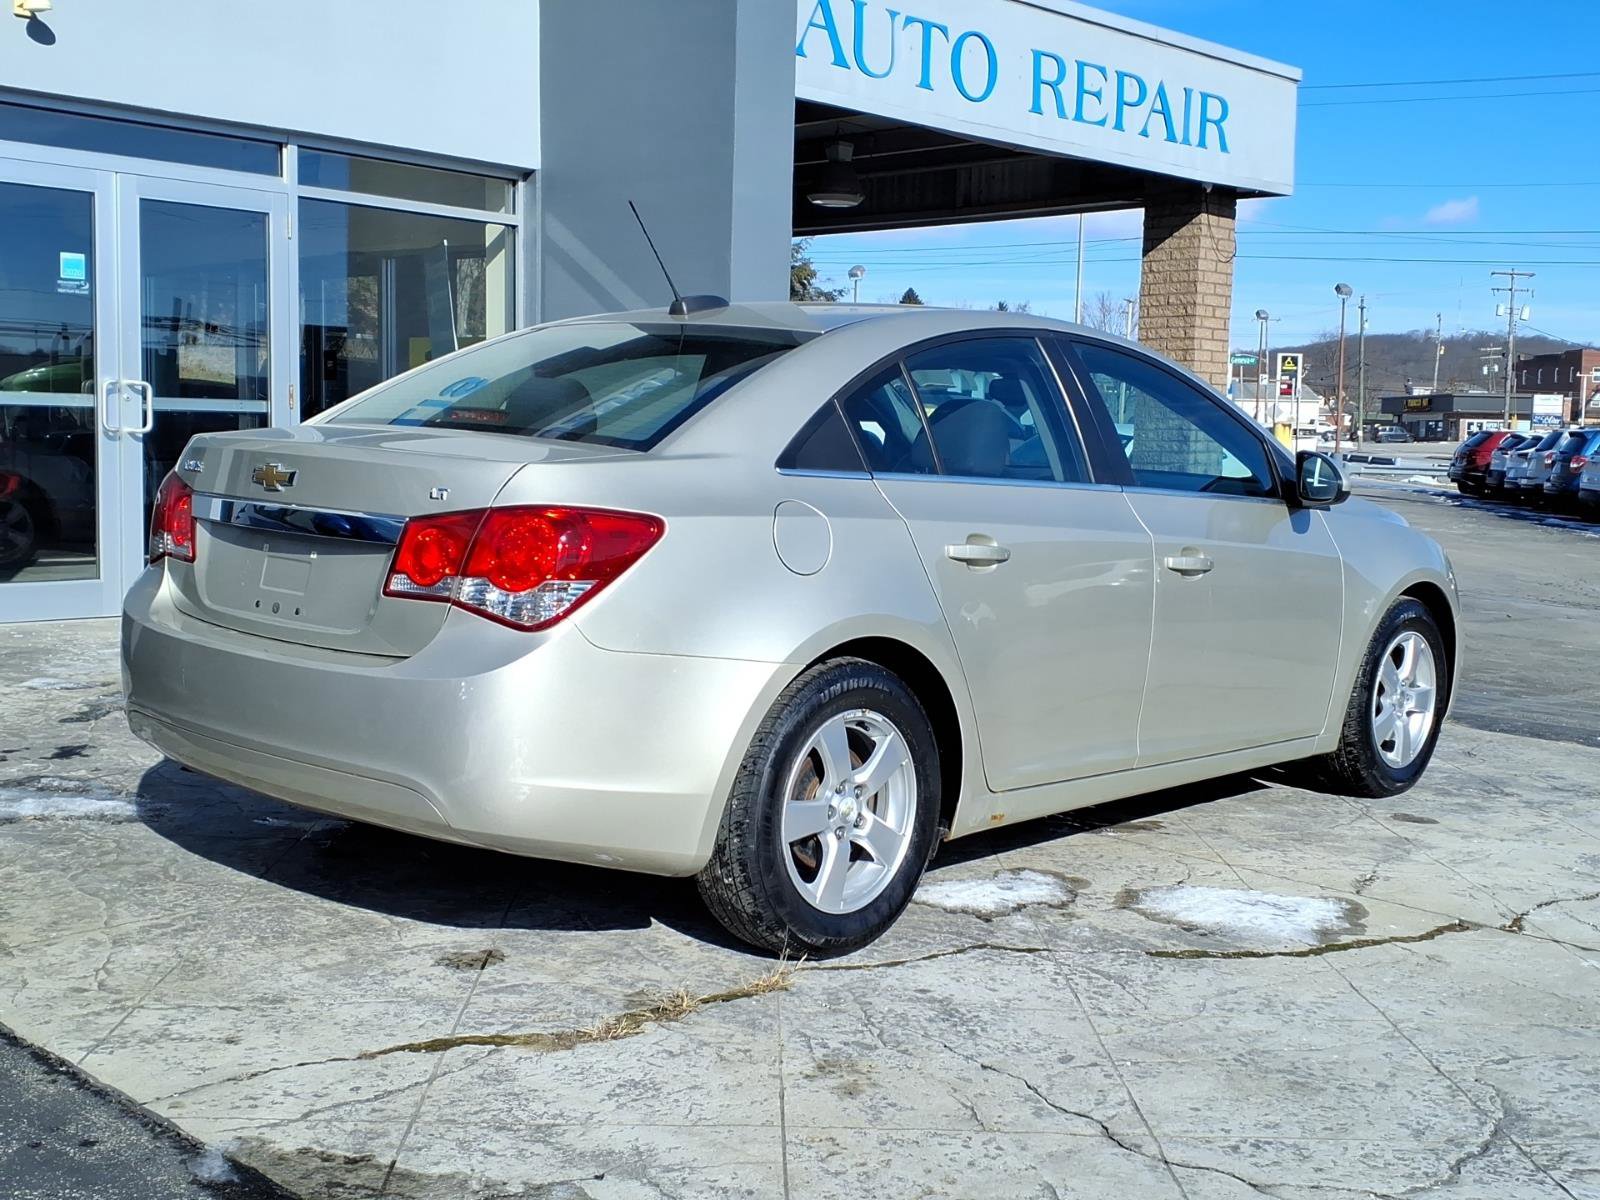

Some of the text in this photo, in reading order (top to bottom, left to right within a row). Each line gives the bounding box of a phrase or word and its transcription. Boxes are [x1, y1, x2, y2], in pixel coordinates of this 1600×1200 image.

[796, 0, 1231, 154] AUTO REPAIR
[429, 487, 451, 500] LT
